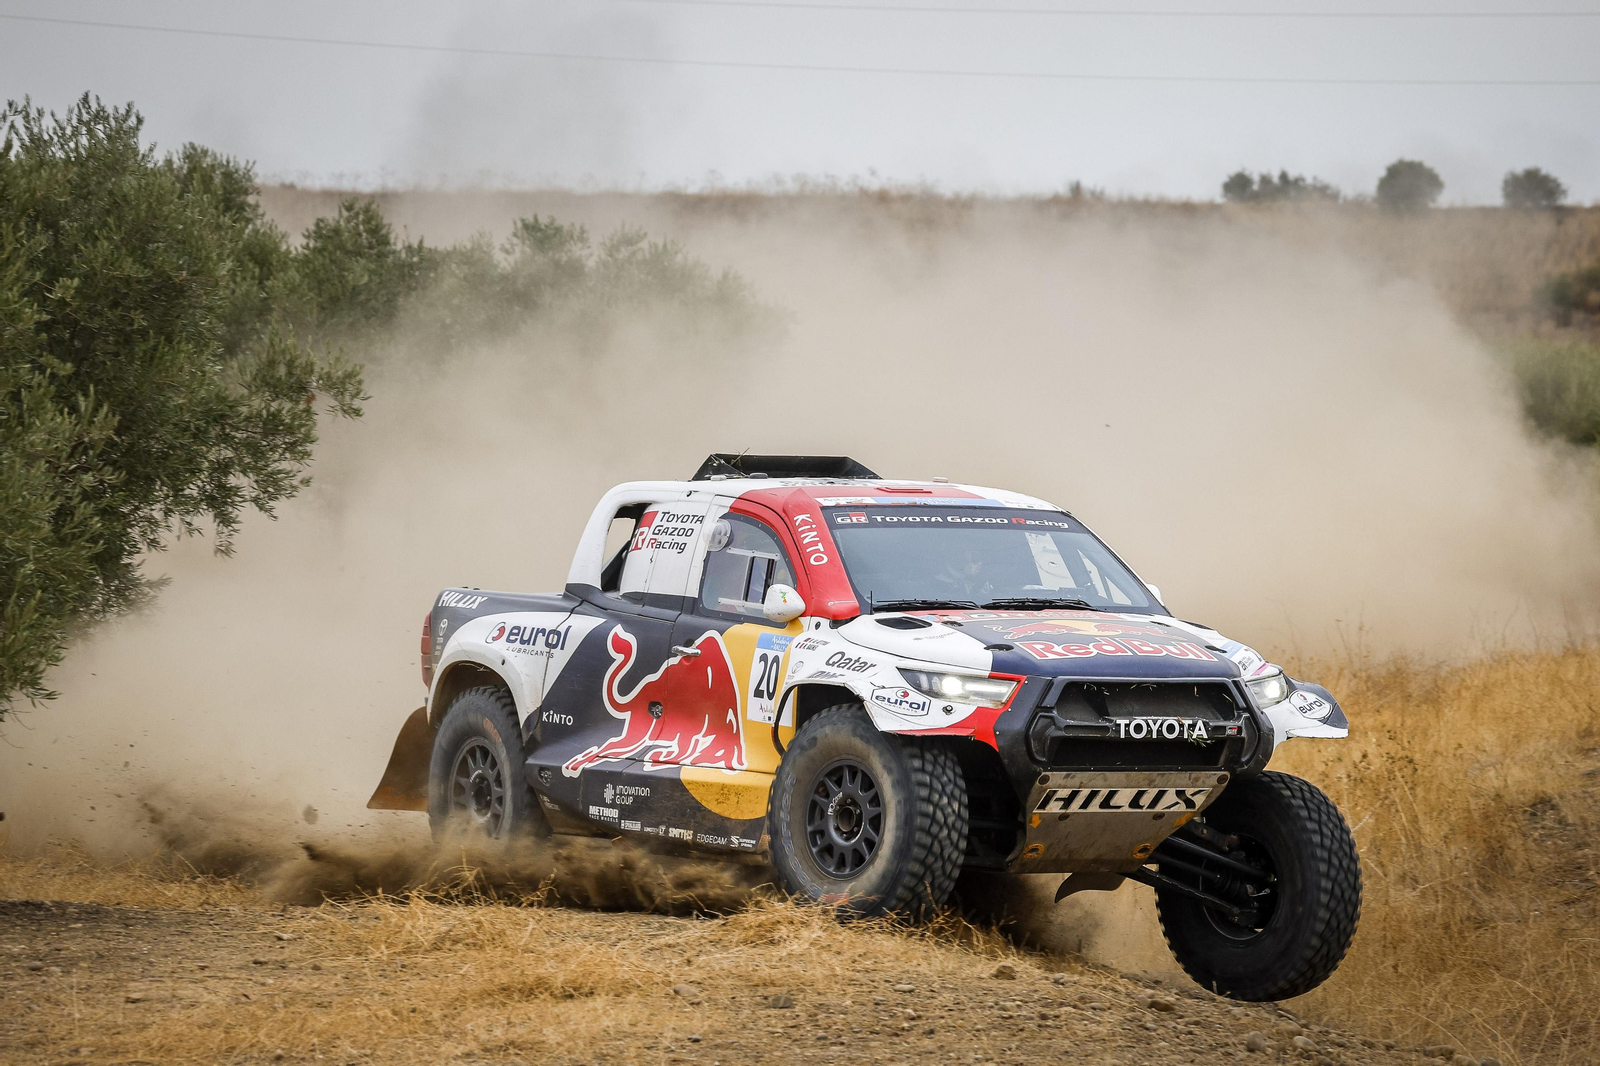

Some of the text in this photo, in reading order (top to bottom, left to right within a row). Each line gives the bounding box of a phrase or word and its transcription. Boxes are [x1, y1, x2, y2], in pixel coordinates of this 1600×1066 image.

[659, 511, 705, 525] TOYOTA
[836, 515, 868, 524] GR
[871, 515, 1069, 529] TOYOTA GAZOO Racing
[652, 525, 695, 537] GAZOO
[646, 538, 688, 554] Racing
[438, 591, 488, 610] HILUX
[505, 624, 572, 650] eurol
[506, 646, 555, 659] LUBRICANTS
[1017, 637, 1130, 660] Red
[1127, 639, 1218, 661] Bull
[825, 651, 877, 673] Qatar
[753, 652, 780, 701] 20
[875, 695, 926, 711] eurol
[1299, 697, 1326, 714] eurol
[1116, 719, 1208, 739] TOYOTA
[1036, 789, 1208, 810] HILUX
[589, 805, 619, 818] METHOD
[697, 833, 728, 846] EDGECAM
